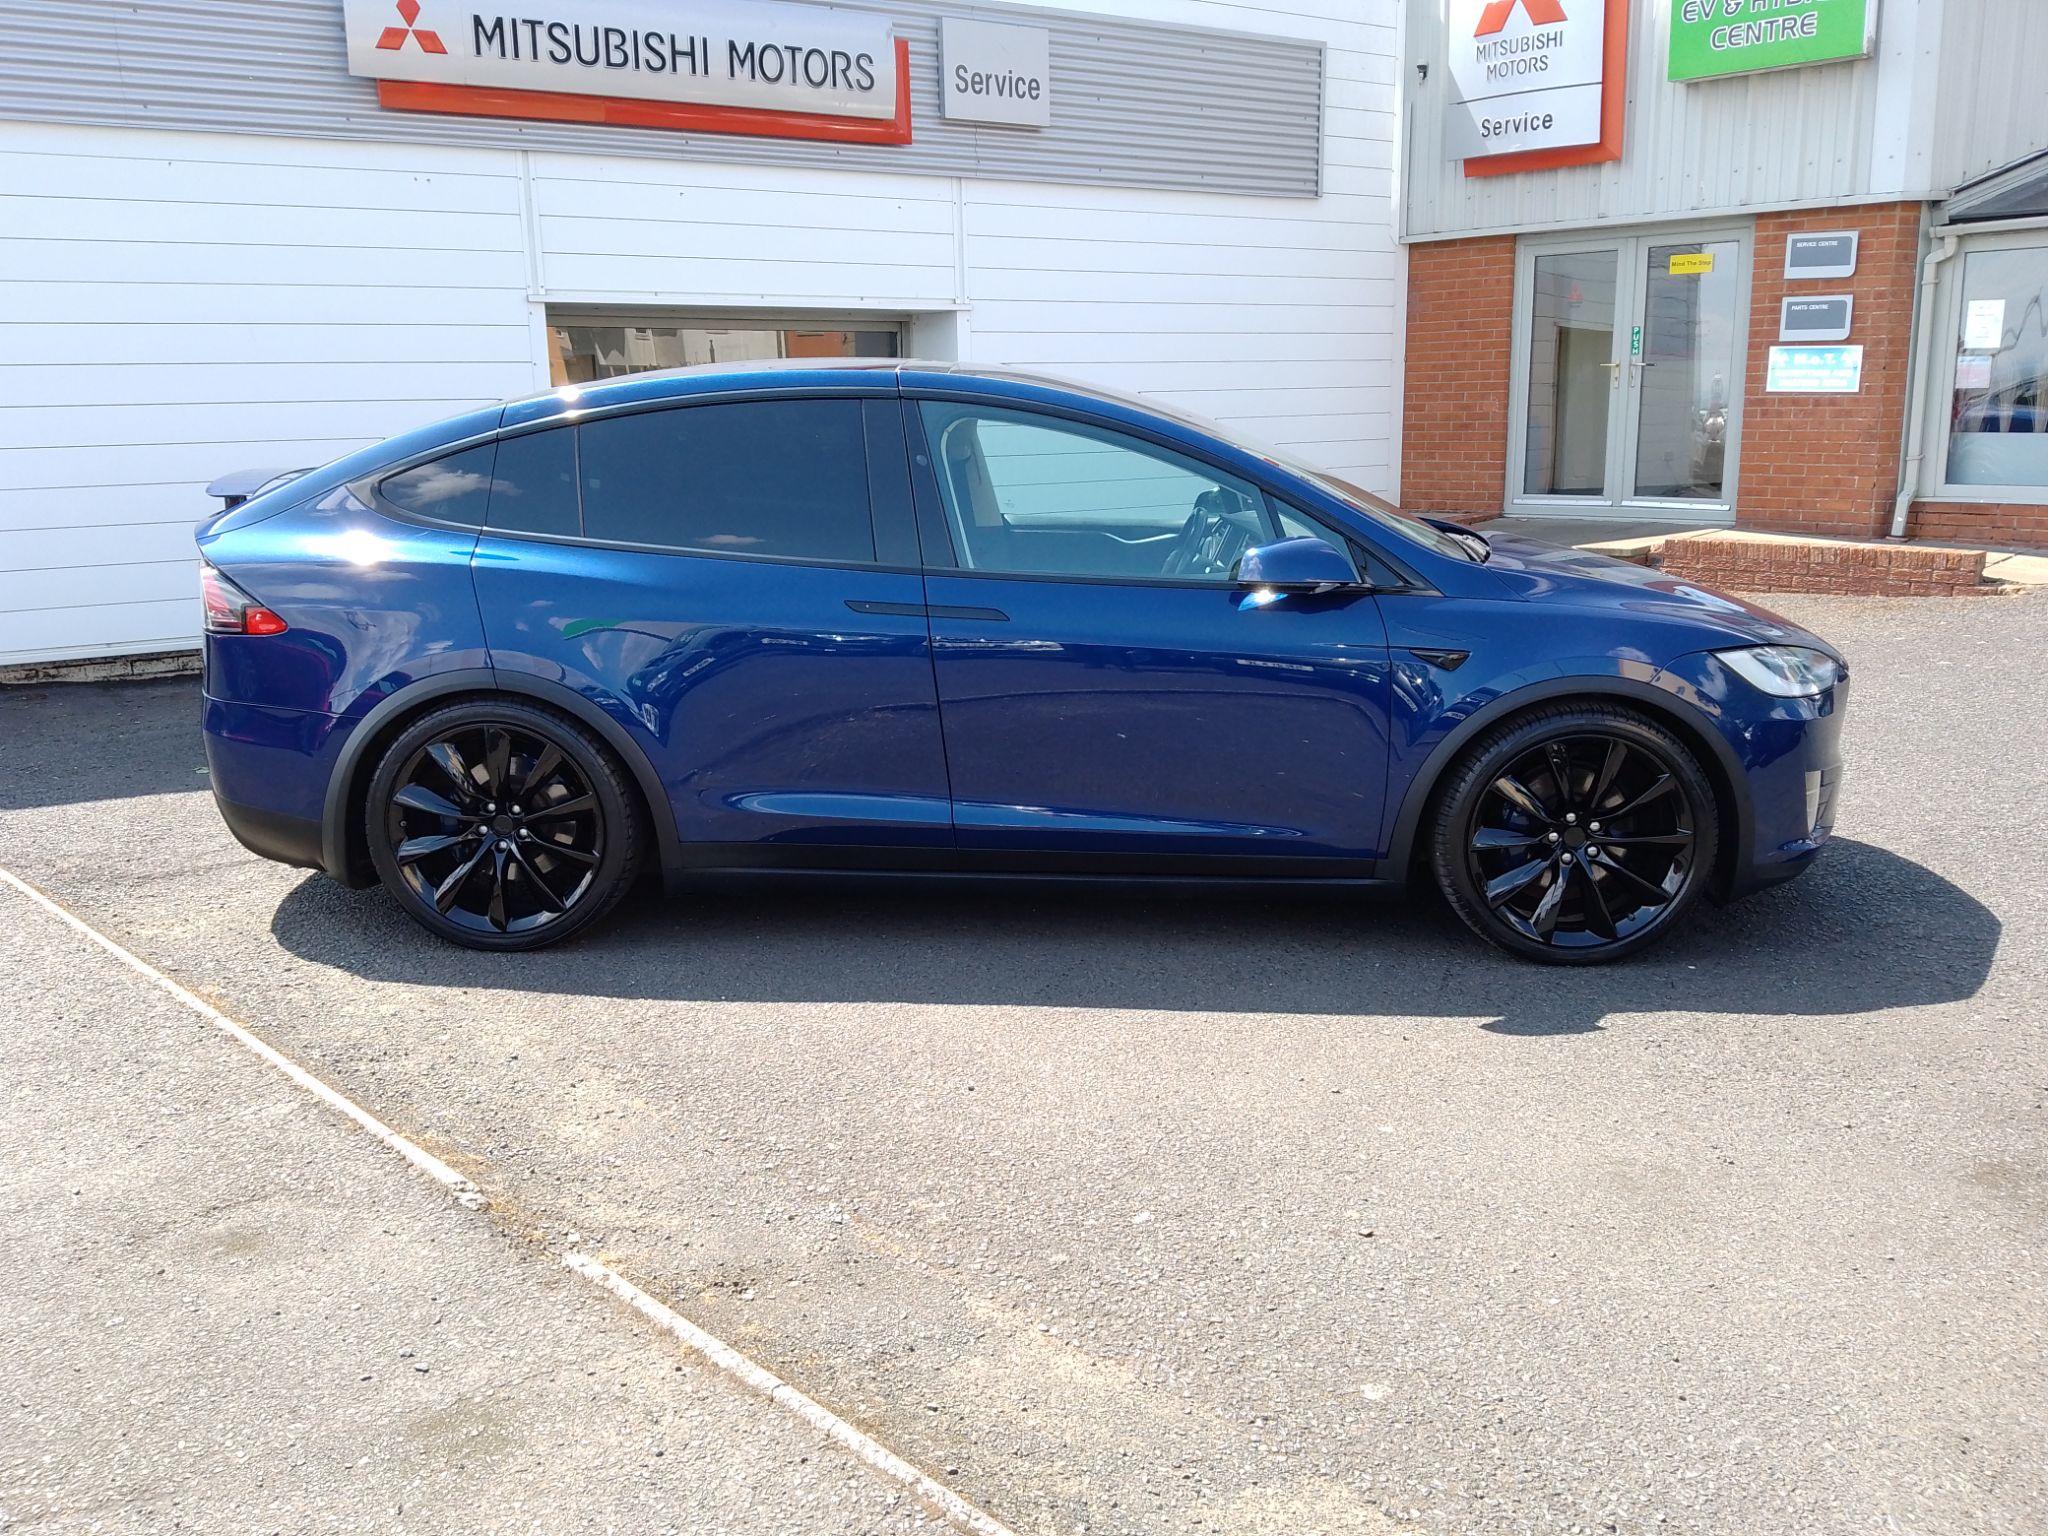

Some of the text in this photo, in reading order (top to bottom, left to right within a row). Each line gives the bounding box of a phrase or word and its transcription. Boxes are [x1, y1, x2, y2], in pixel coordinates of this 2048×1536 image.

[1682, 0, 1718, 23] EV
[1476, 28, 1564, 63] MITSUBISHI
[1710, 11, 1818, 50] CENTRE
[471, 13, 876, 92] MITSUBISHI MOTORS
[1486, 54, 1549, 81] MOTORS
[954, 64, 1041, 100] Service
[1481, 111, 1554, 138] Service
[1632, 327, 1640, 354] PUSH
